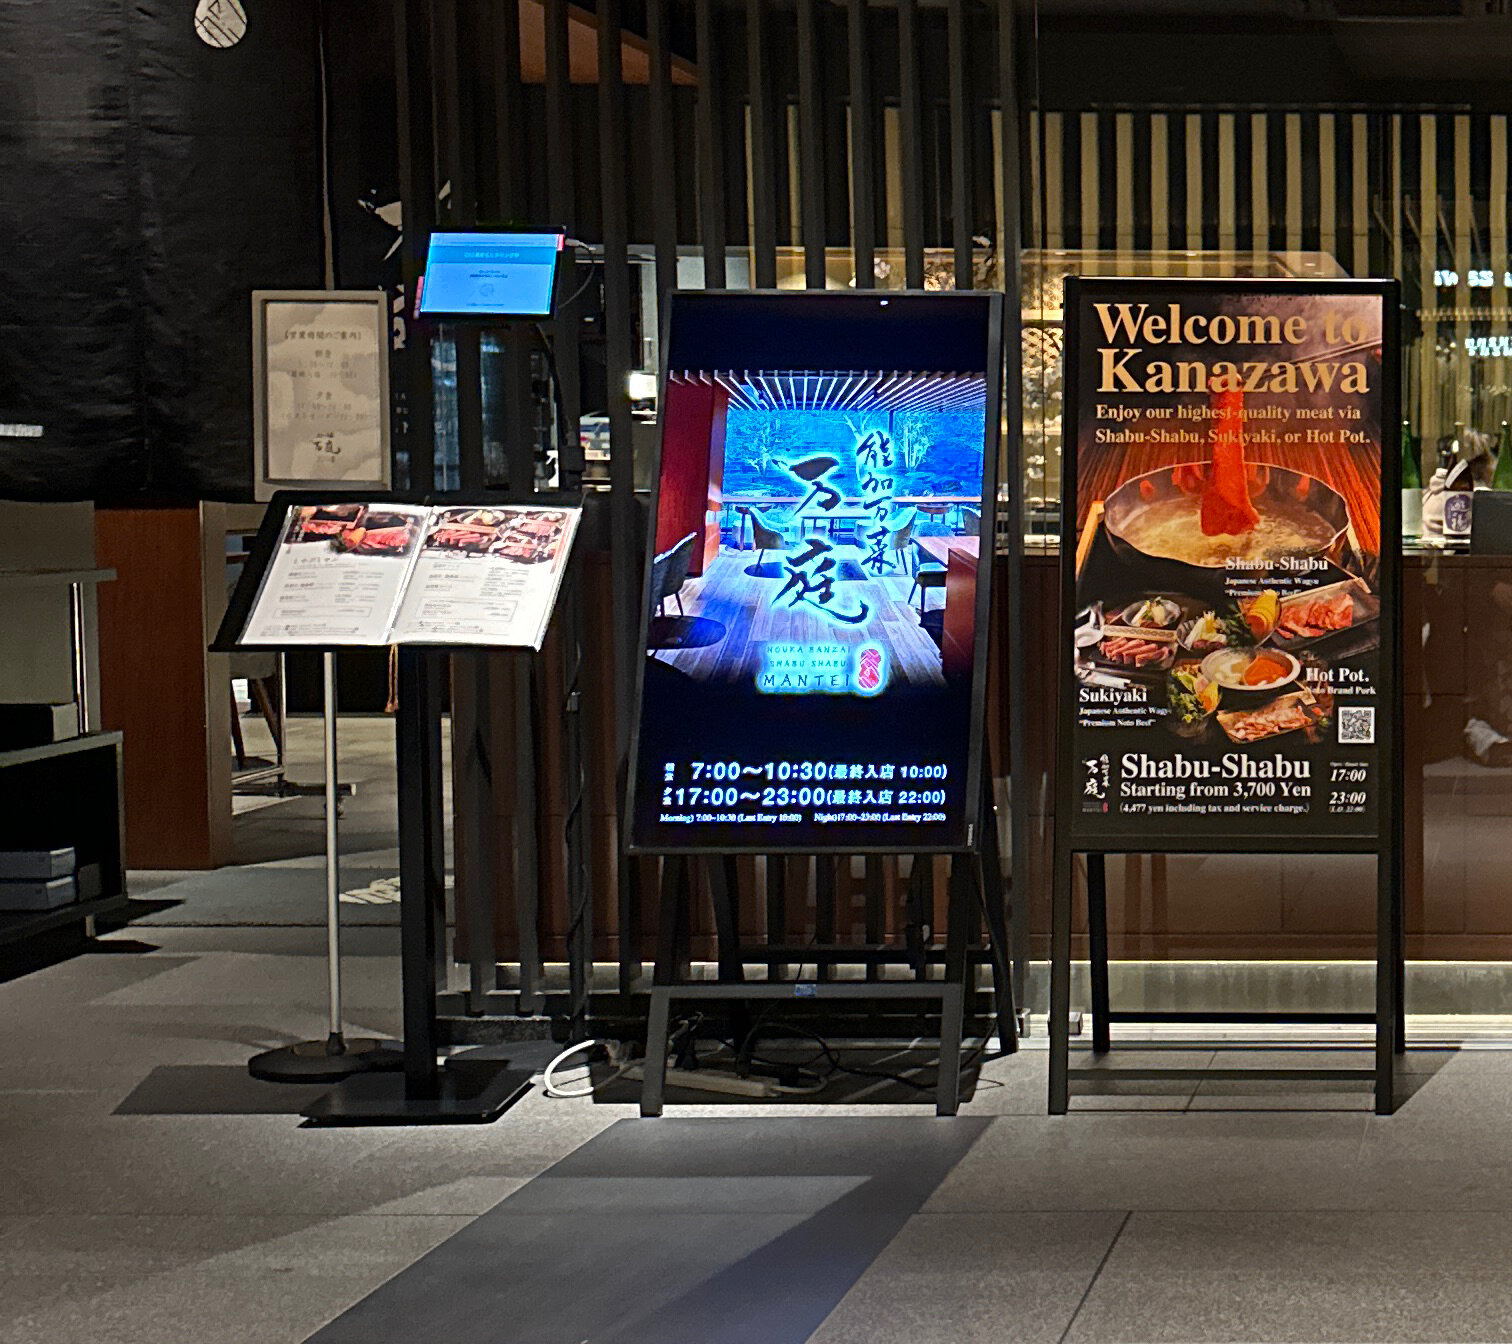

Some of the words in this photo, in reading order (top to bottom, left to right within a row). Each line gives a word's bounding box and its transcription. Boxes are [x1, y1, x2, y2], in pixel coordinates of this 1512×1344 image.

[1094, 303, 1307, 345] Welcome
[1324, 310, 1369, 345] to
[1096, 348, 1370, 394] Kanazawa
[1096, 404, 1140, 421] Enjoy
[1146, 408, 1173, 419] our
[1177, 404, 1290, 422] highest-quality
[1296, 406, 1334, 419] meat
[1339, 404, 1361, 419] via
[1095, 428, 1204, 445] Shabu-Shabu,
[1207, 429, 1281, 446] Sukiyaki,
[1285, 432, 1302, 443] or
[1306, 429, 1334, 443] Hot
[1339, 429, 1371, 444] Pot.
[856, 430, 896, 574] 能加万菜
[771, 456, 869, 625] 万庭
[1225, 556, 1329, 571] Shabu-Shabu
[763, 673, 850, 687] MANTEI
[1306, 667, 1334, 682] Hot
[1338, 667, 1370, 682] Pot.
[1079, 688, 1147, 705] Sukiyaki
[900, 764, 948, 780] 10:00)
[1121, 753, 1311, 779] Shabu-Shabu
[1330, 769, 1367, 782] 17:00
[898, 789, 946, 805] 22:00)
[1120, 782, 1186, 800] Starting
[1190, 782, 1229, 796] from
[1233, 782, 1276, 799] 3,700
[1280, 782, 1311, 796] Yen
[1329, 791, 1367, 805] 23:00
[1120, 802, 1146, 814] (4,477
[1148, 804, 1164, 814] yen
[1165, 803, 1206, 814] including
[1208, 803, 1222, 813] tax
[1223, 803, 1240, 812] and
[1242, 803, 1272, 812] service
